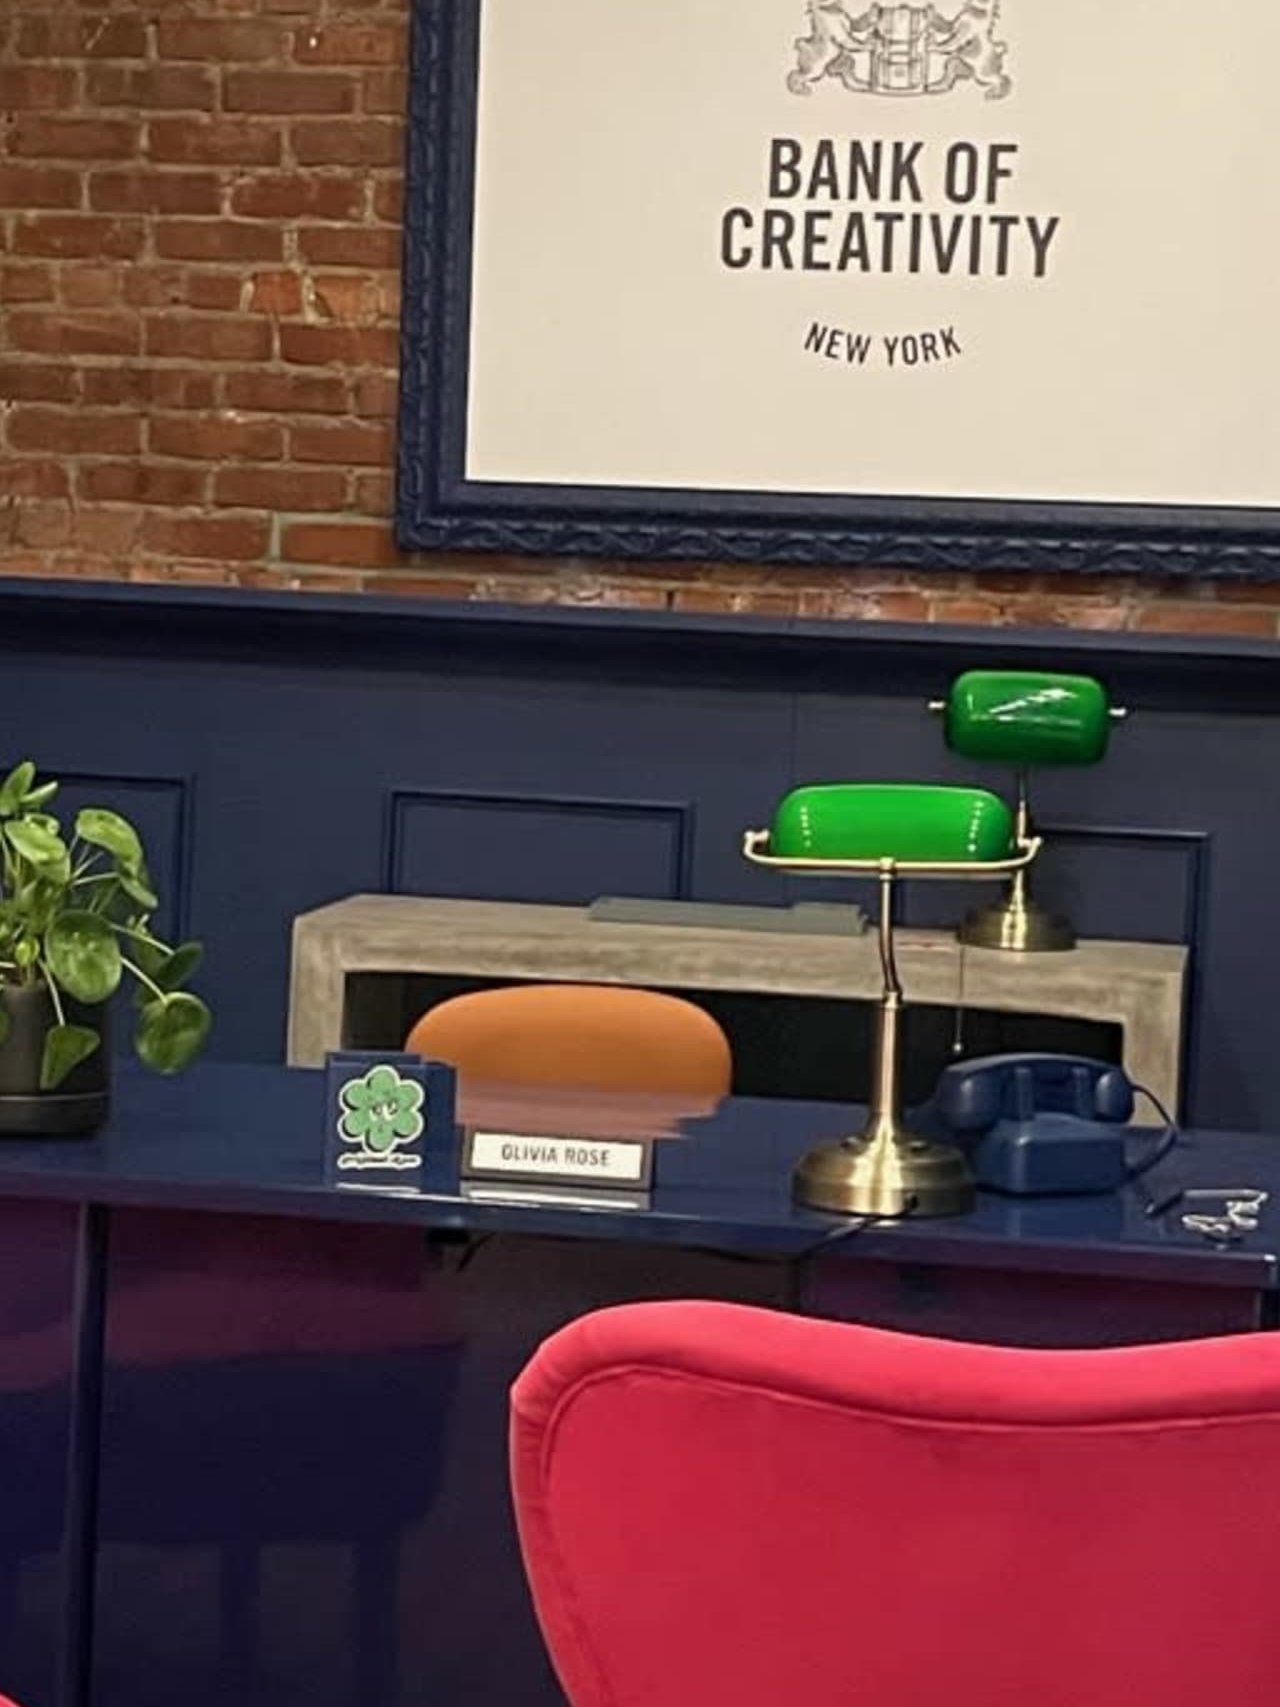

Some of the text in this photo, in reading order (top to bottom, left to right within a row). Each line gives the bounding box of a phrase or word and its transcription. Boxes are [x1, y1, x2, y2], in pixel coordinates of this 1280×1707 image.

[768, 138, 1017, 204] BANK OF
[721, 207, 1059, 277] CREATIVITY
[804, 322, 961, 367] NEW YORK
[501, 1143, 611, 1167] OLIVIA ROSE
